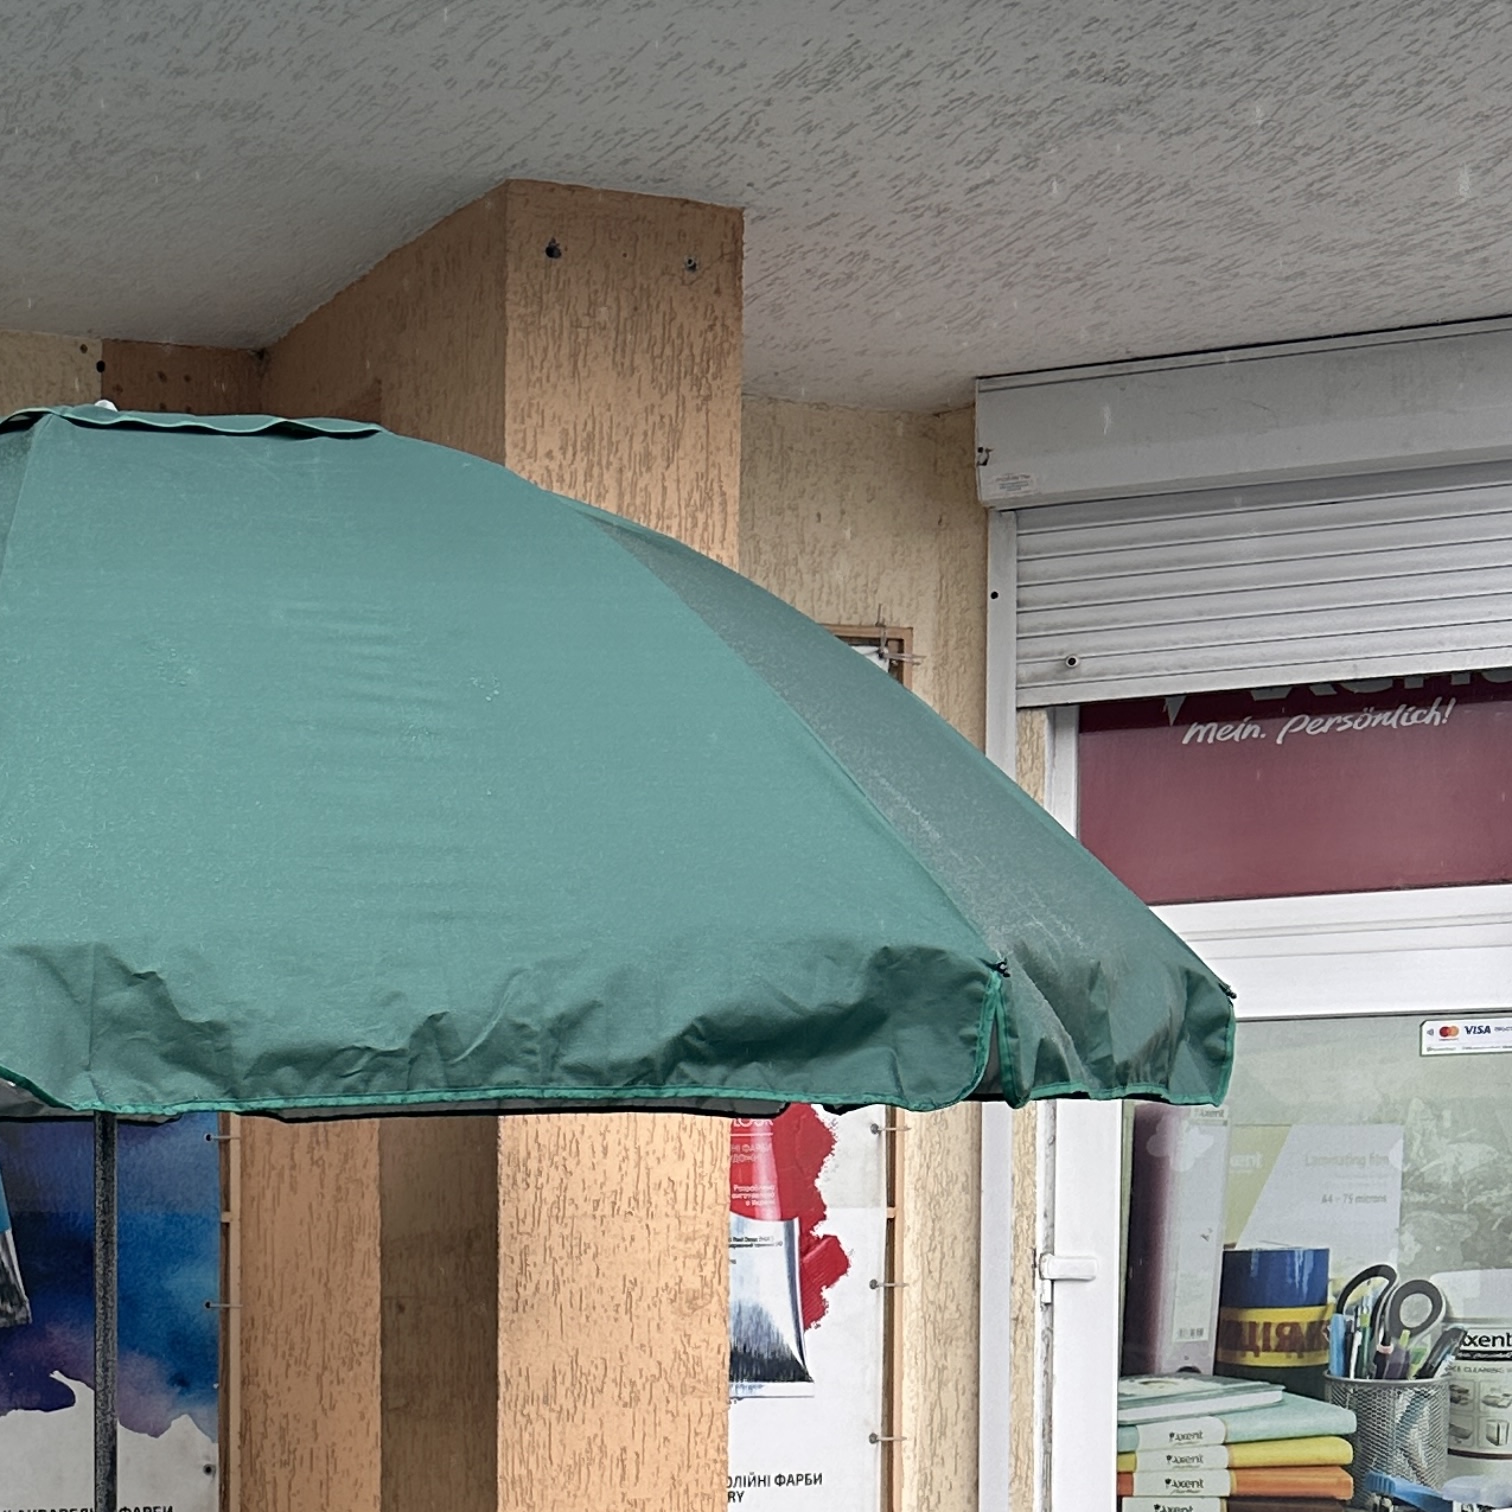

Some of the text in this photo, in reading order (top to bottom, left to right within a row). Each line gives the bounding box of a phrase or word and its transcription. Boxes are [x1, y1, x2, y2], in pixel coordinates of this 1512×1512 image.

[1464, 1025, 1491, 1035] VISA
[774, 1472, 823, 1487] ФАРБИ
[1171, 1478, 1205, 1490] Axent
